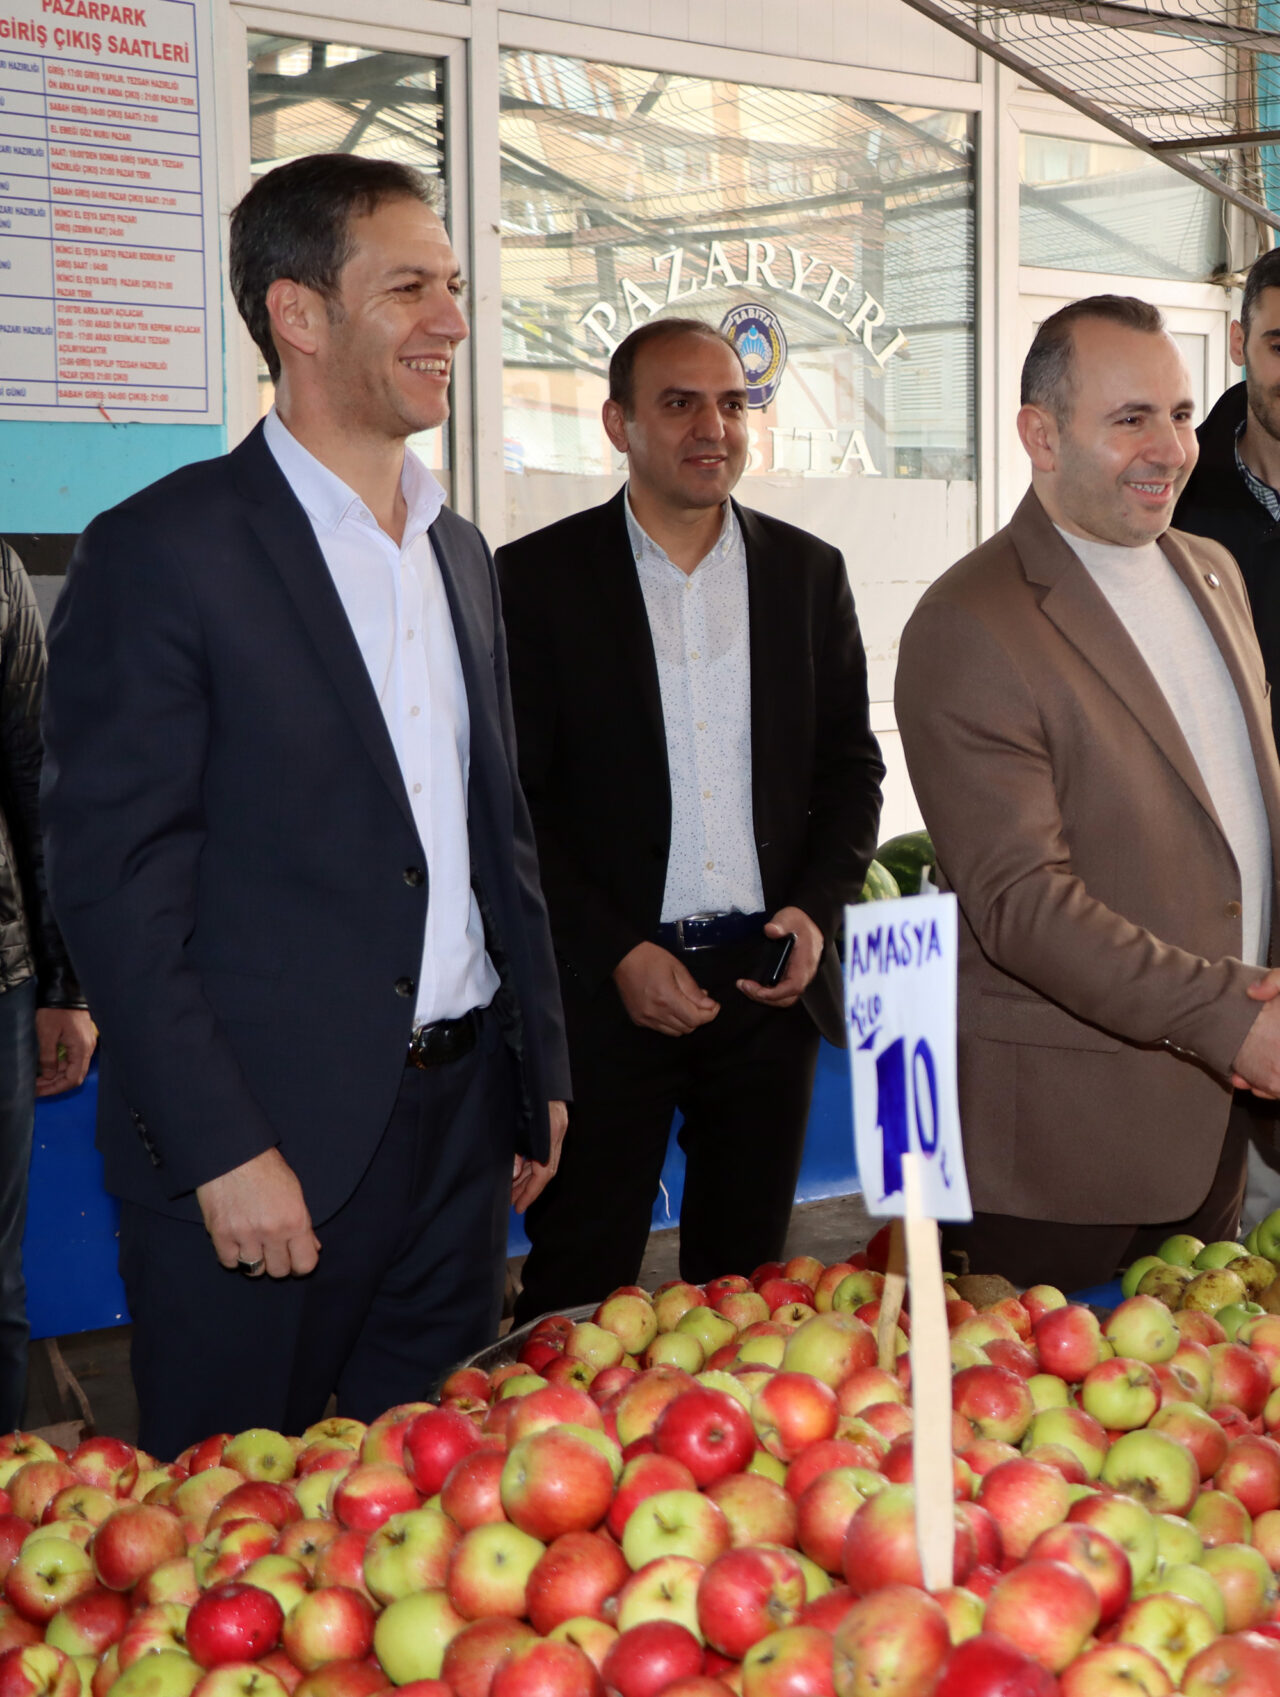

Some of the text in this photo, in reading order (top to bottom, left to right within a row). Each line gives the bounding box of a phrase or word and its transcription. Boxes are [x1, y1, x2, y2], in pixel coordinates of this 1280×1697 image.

[0, 17, 189, 63] GİRİŞ ÇIKIŞ SAATLERİ
[42, 0, 147, 27] PAZARPARK
[851, 917, 943, 982] AMASYA
[874, 1035, 940, 1201] 10
